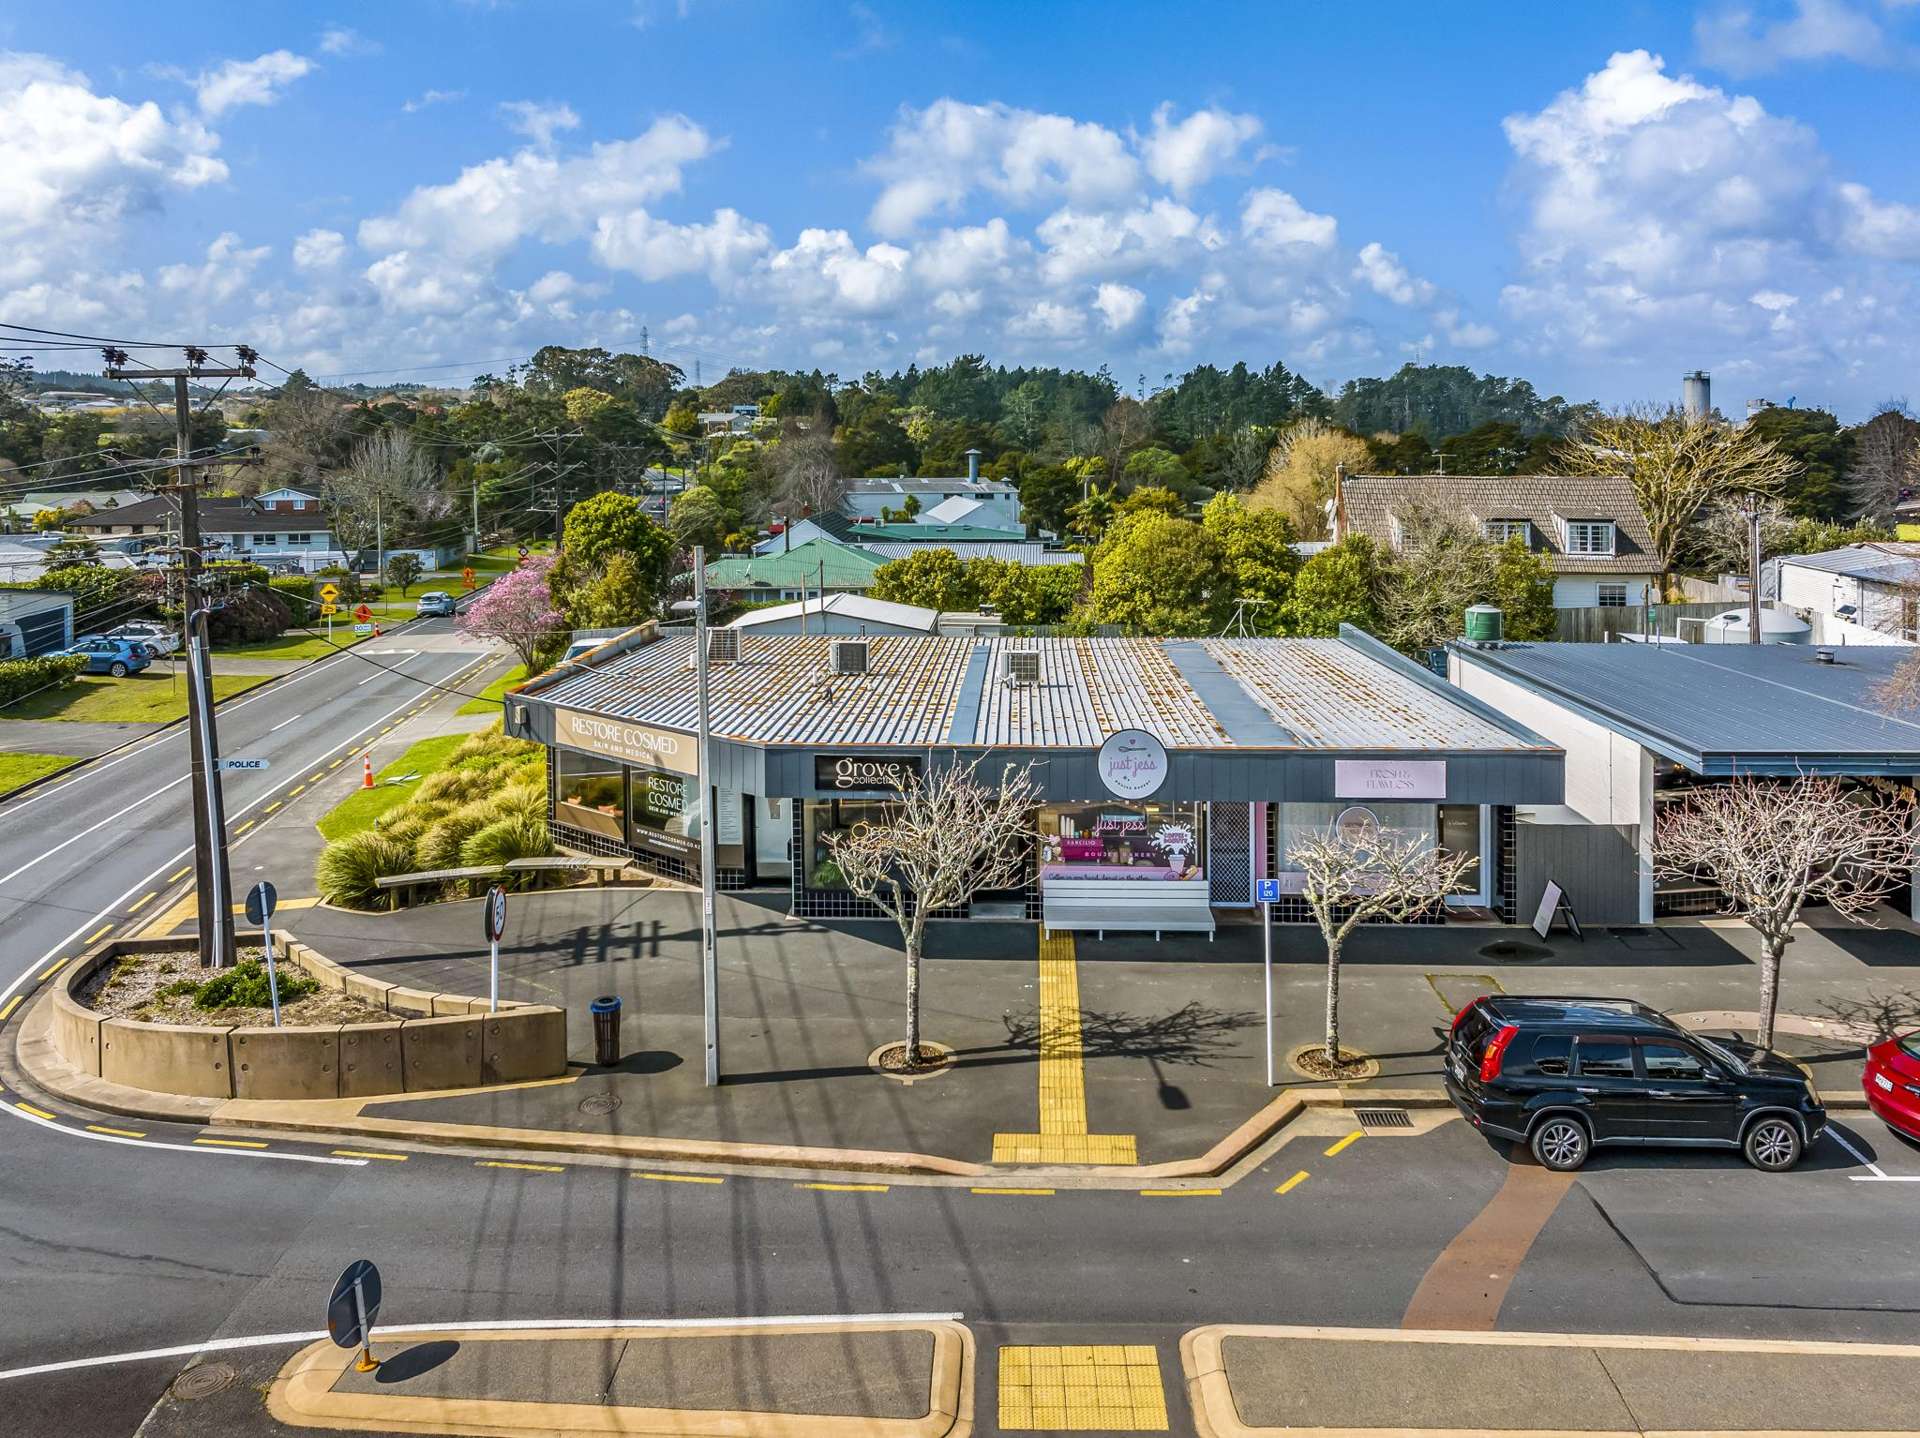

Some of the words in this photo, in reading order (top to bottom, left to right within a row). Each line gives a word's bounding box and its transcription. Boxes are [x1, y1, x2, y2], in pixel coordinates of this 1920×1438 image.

[572, 717, 622, 742] RESTORE
[624, 728, 678, 755] COSMED
[229, 760, 261, 769] POLICE
[835, 757, 900, 789] grove
[648, 776, 688, 798] RESTORE
[648, 791, 689, 814] COSMED
[1264, 881, 1271, 890] P
